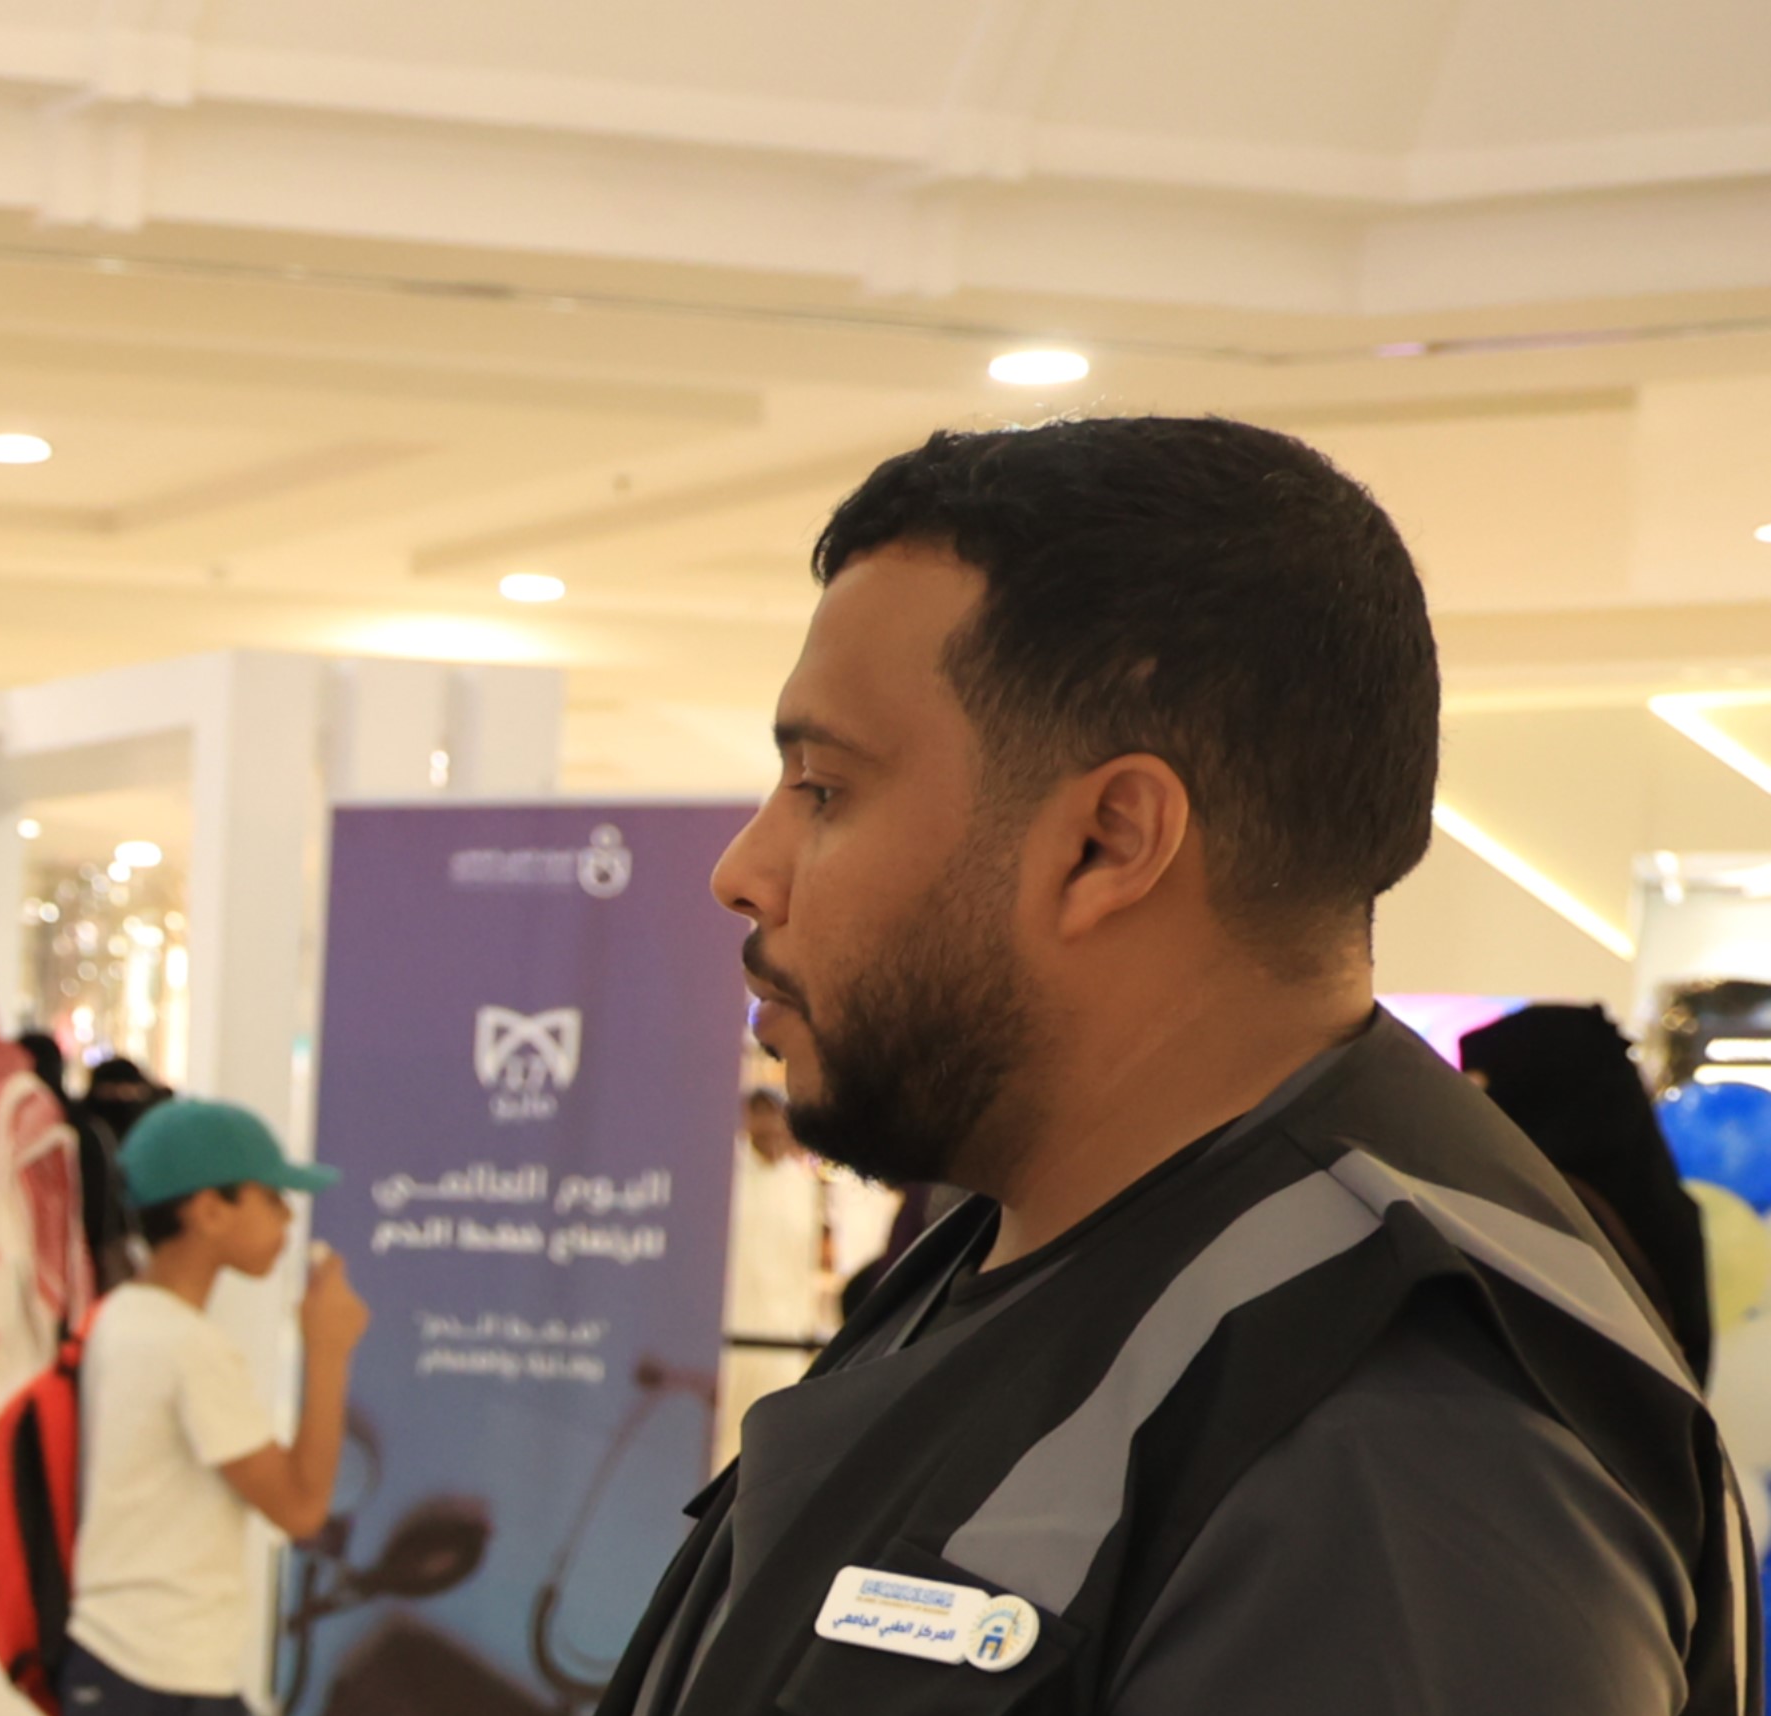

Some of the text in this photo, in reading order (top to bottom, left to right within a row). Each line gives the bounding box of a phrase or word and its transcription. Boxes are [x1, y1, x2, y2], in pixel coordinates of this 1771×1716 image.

[833, 1613, 956, 1642] المركز الطبي الجامعي
